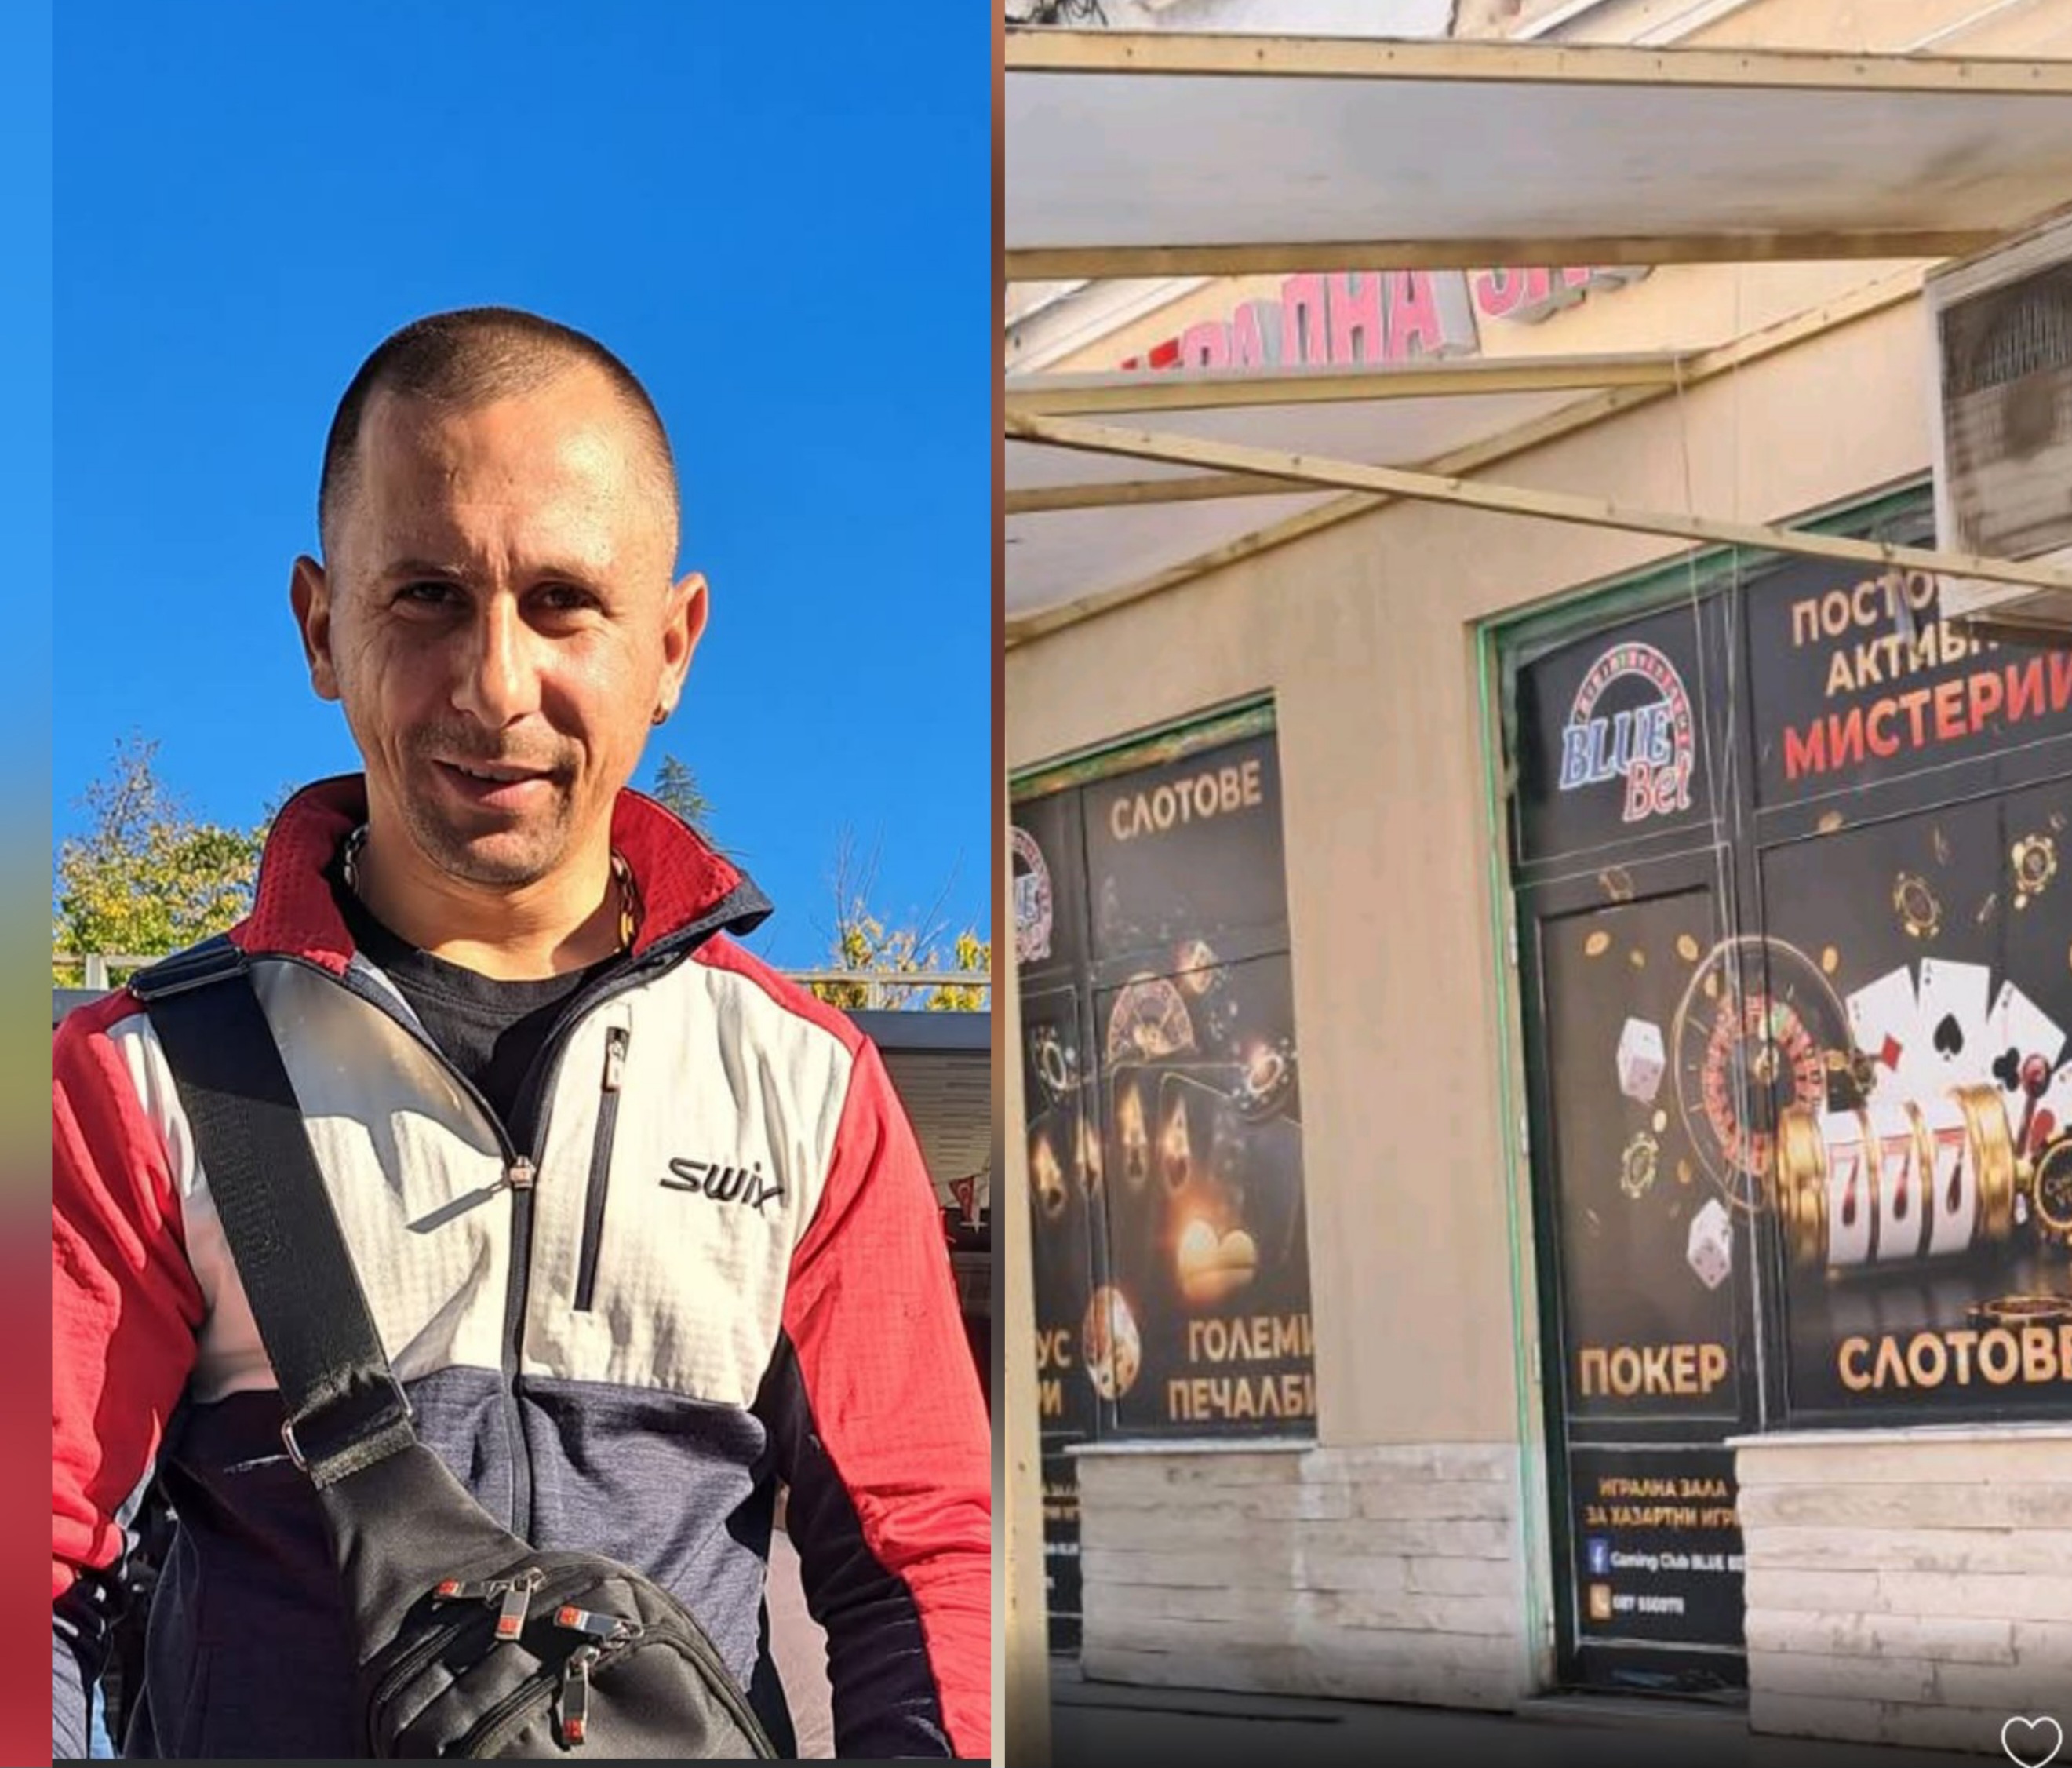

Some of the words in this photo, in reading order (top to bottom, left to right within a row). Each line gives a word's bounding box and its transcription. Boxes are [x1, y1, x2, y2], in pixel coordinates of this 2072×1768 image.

[1792, 570, 1935, 647] ПОСТО
[1560, 699, 1673, 790] BLUE
[1110, 760, 1263, 840] СЛОТОВЕ
[1622, 750, 1691, 822] Bet
[1580, 1343, 1728, 1396] ПОКЕР
